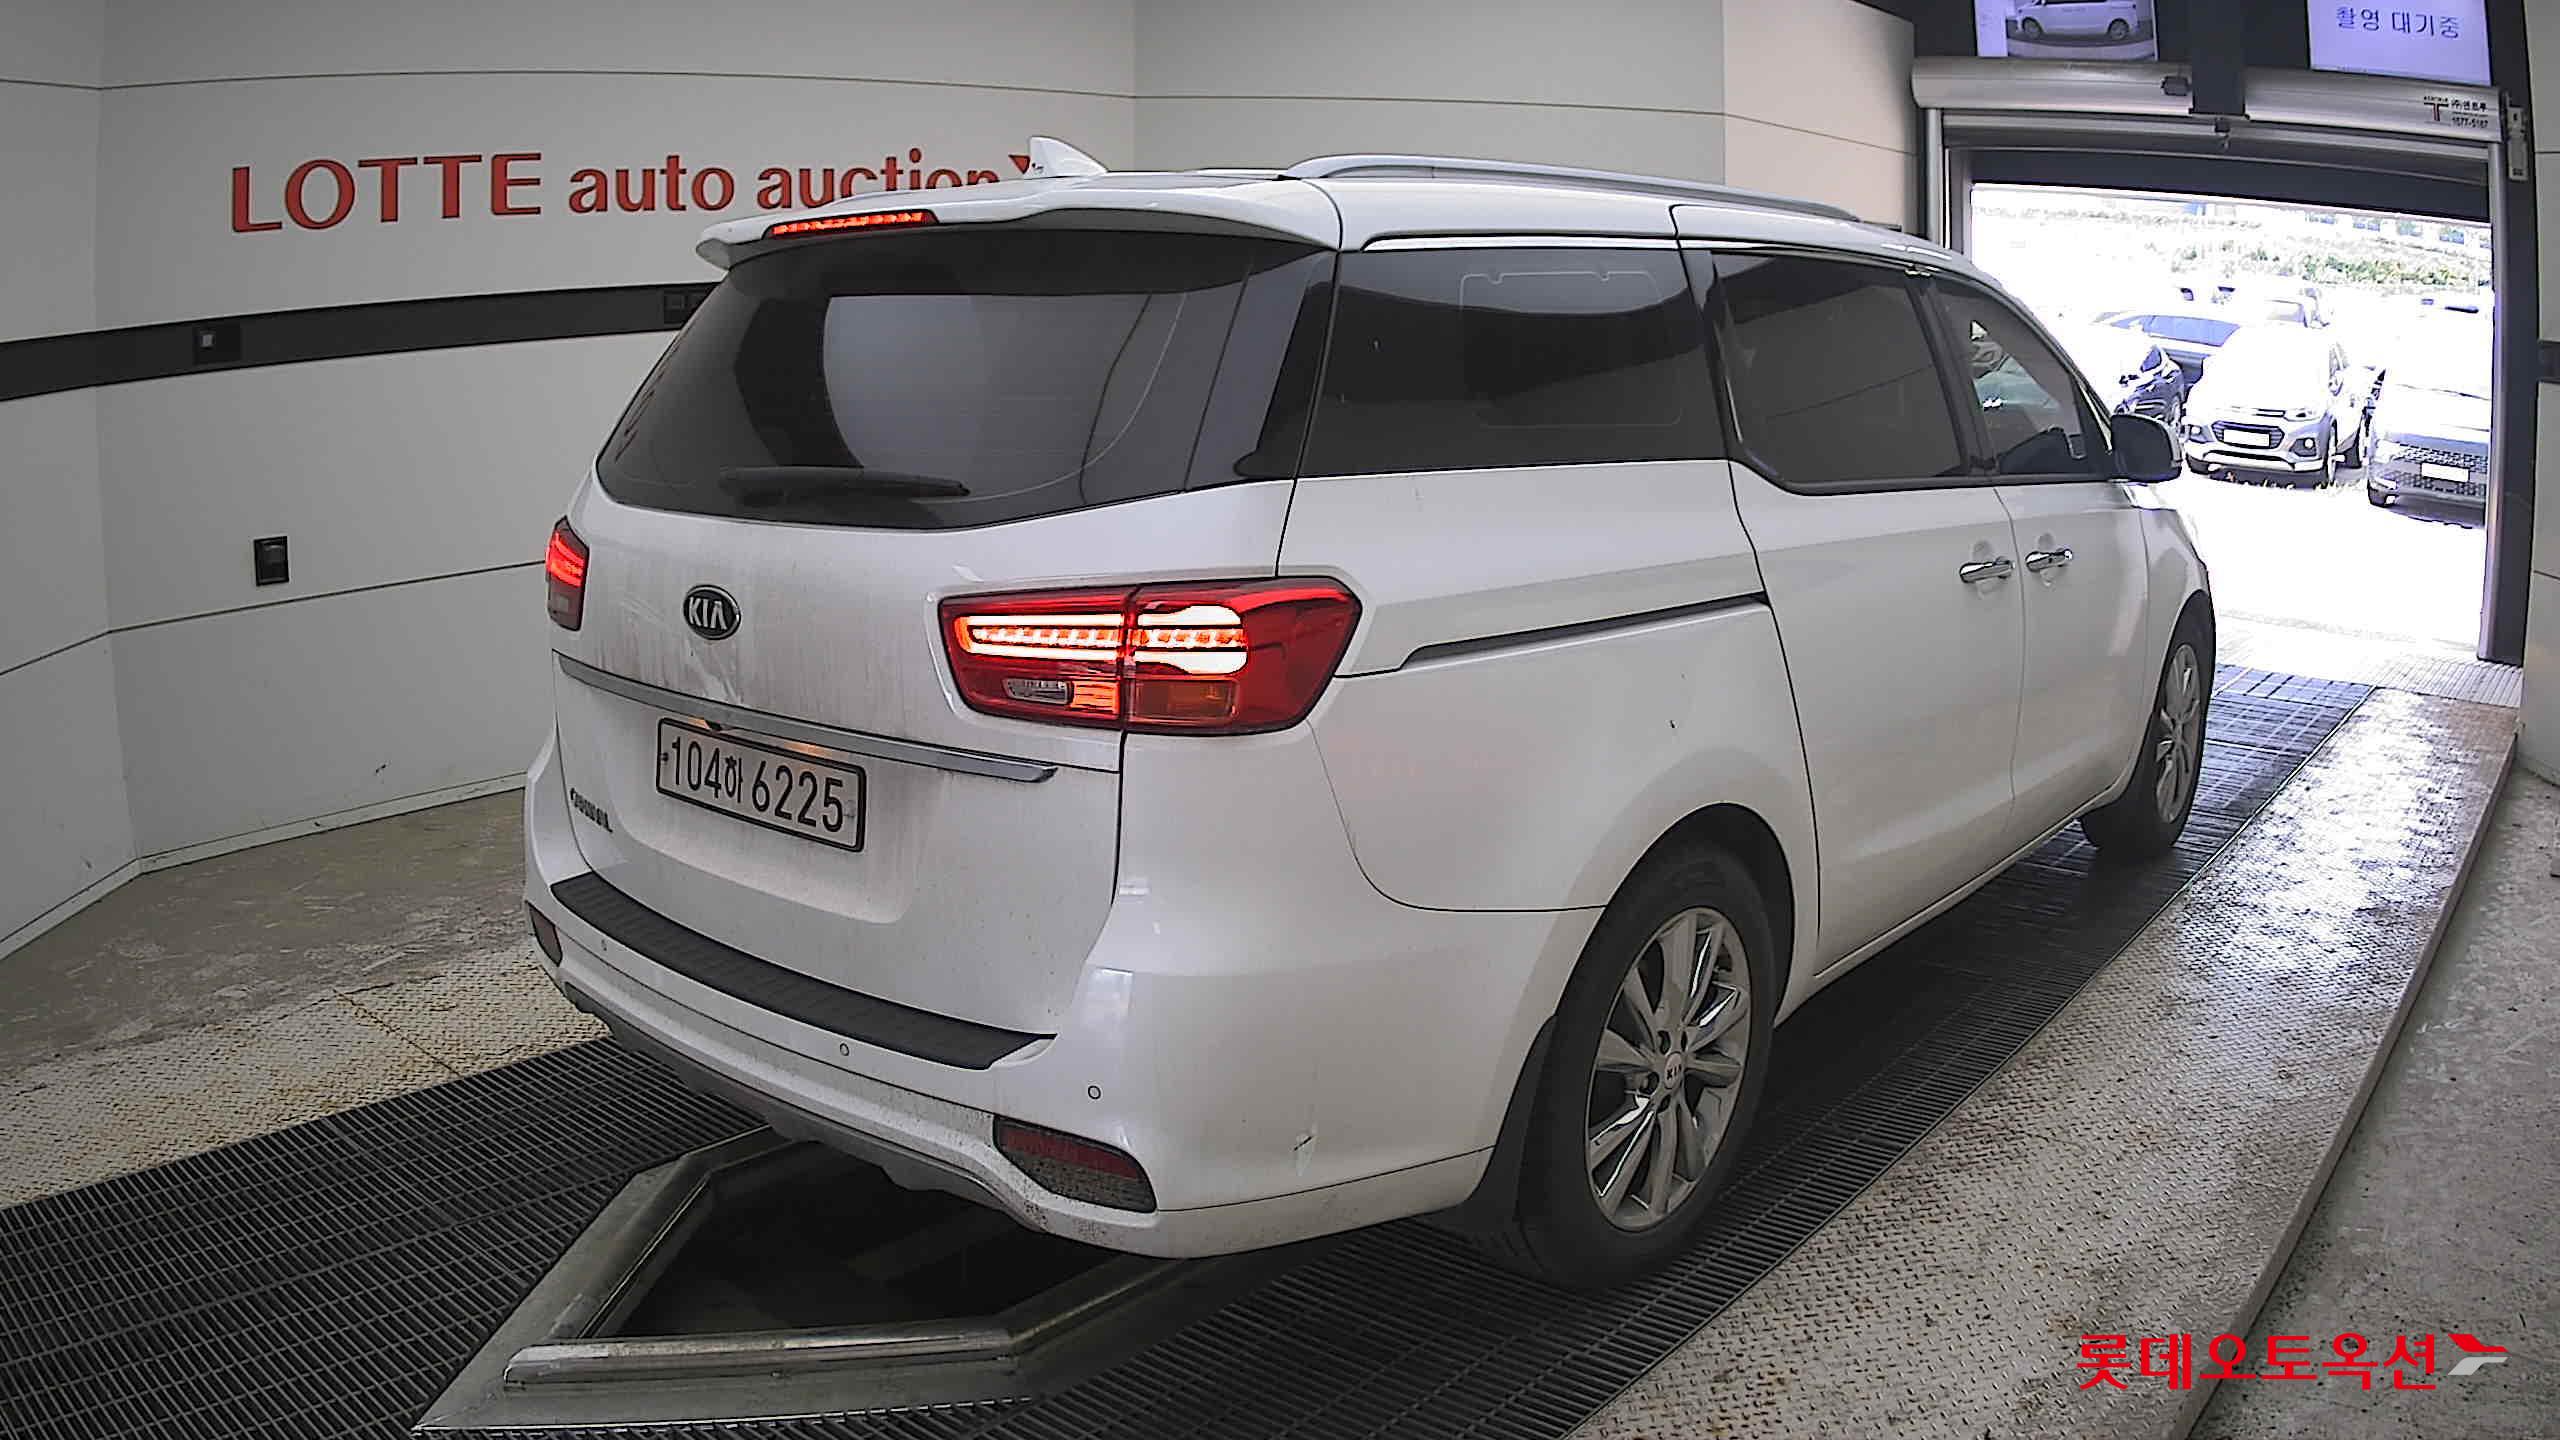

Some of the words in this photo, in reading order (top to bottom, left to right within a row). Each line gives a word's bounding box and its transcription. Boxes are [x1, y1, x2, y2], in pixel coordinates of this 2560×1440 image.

[2337, 6, 2380, 32] 촬영
[2391, 12, 2460, 39] 대기중
[232, 152, 541, 233] LOTTE
[568, 154, 735, 214] auto
[688, 596, 727, 630] KIA
[672, 736, 744, 803] 104하
[752, 760, 844, 833] 6225
